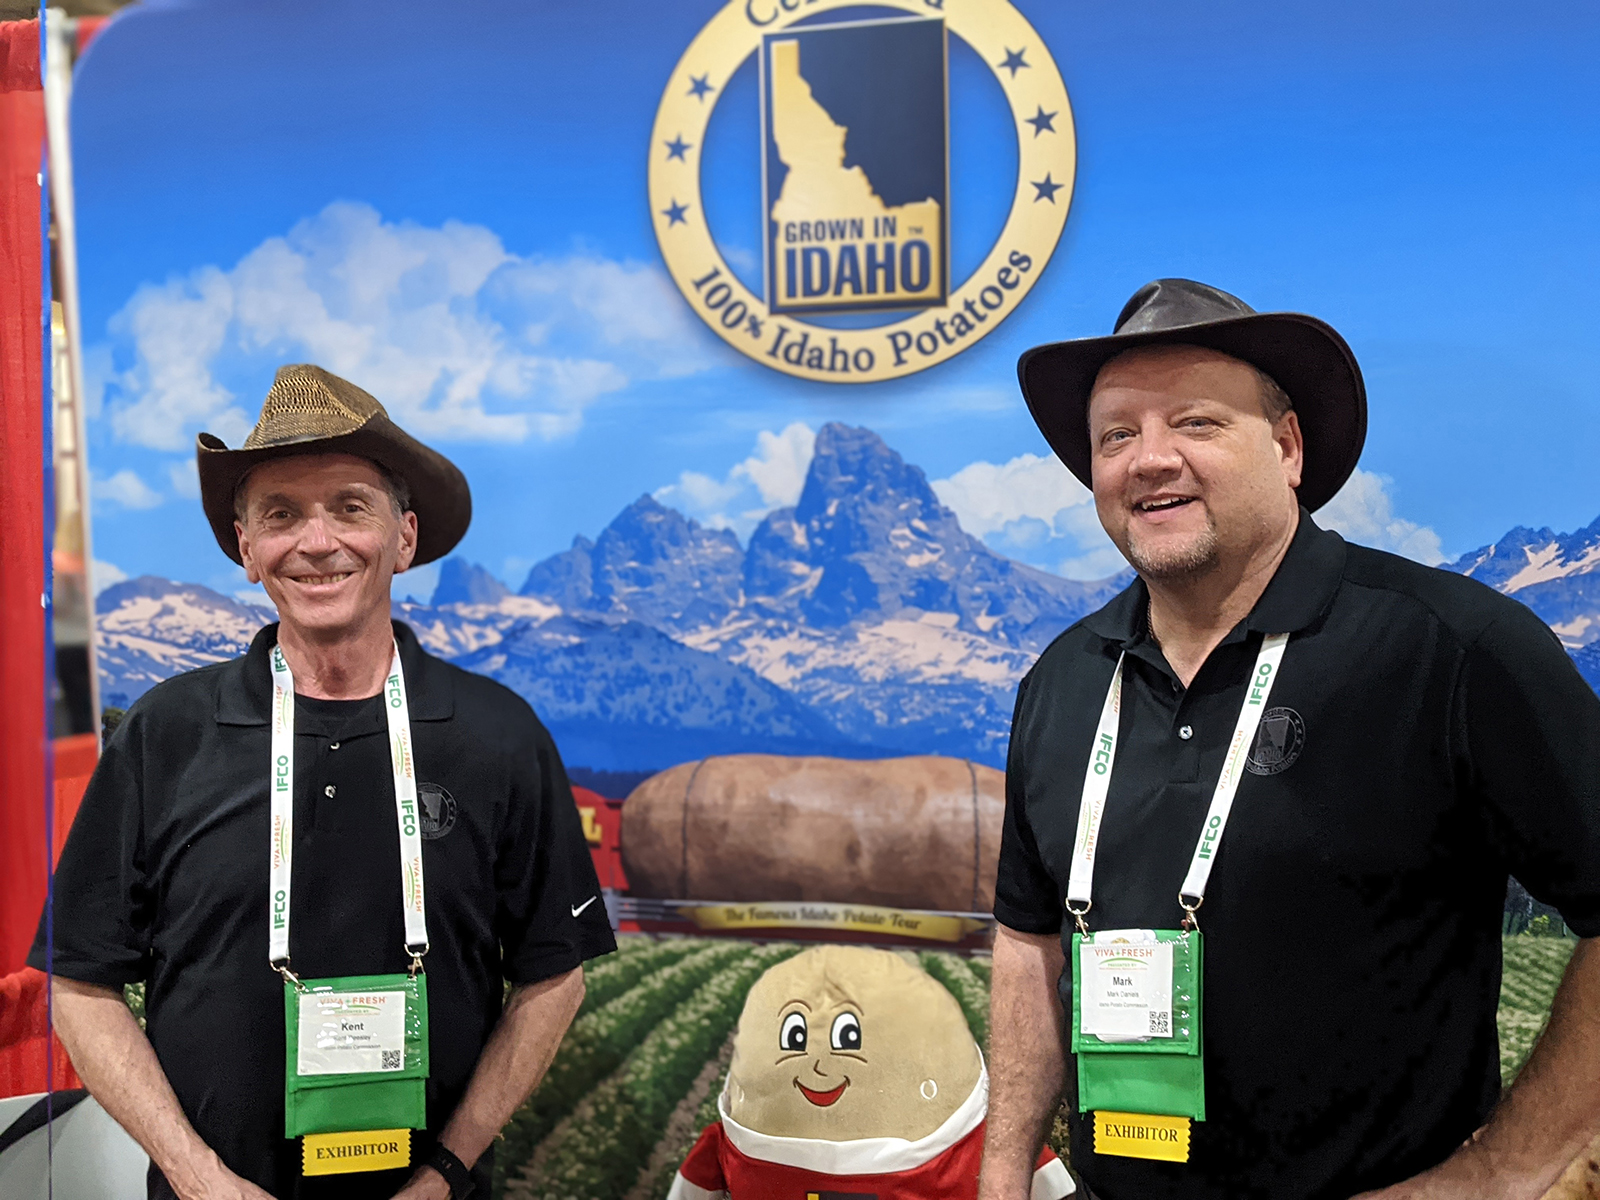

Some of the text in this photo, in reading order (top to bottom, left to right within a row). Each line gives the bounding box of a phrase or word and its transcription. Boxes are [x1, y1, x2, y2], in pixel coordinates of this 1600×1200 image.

[785, 216, 896, 243] GROWN IN
[785, 239, 931, 298] IDAHO
[692, 250, 1032, 373] 100% Idaho Potatoes
[387, 674, 402, 708] IFCO
[1248, 662, 1273, 705] IFCO
[1093, 732, 1113, 775] IFCO
[276, 755, 289, 792] IFCO
[401, 799, 416, 837] IFCO
[1198, 815, 1222, 860] IFCO
[273, 889, 287, 930] IFCO
[889, 913, 922, 930] Tour
[1112, 976, 1133, 986] Mark
[341, 1022, 364, 1031] Kent
[315, 1141, 399, 1160] EXHIBITOR
[1104, 1123, 1179, 1143] EXHIBITOR
